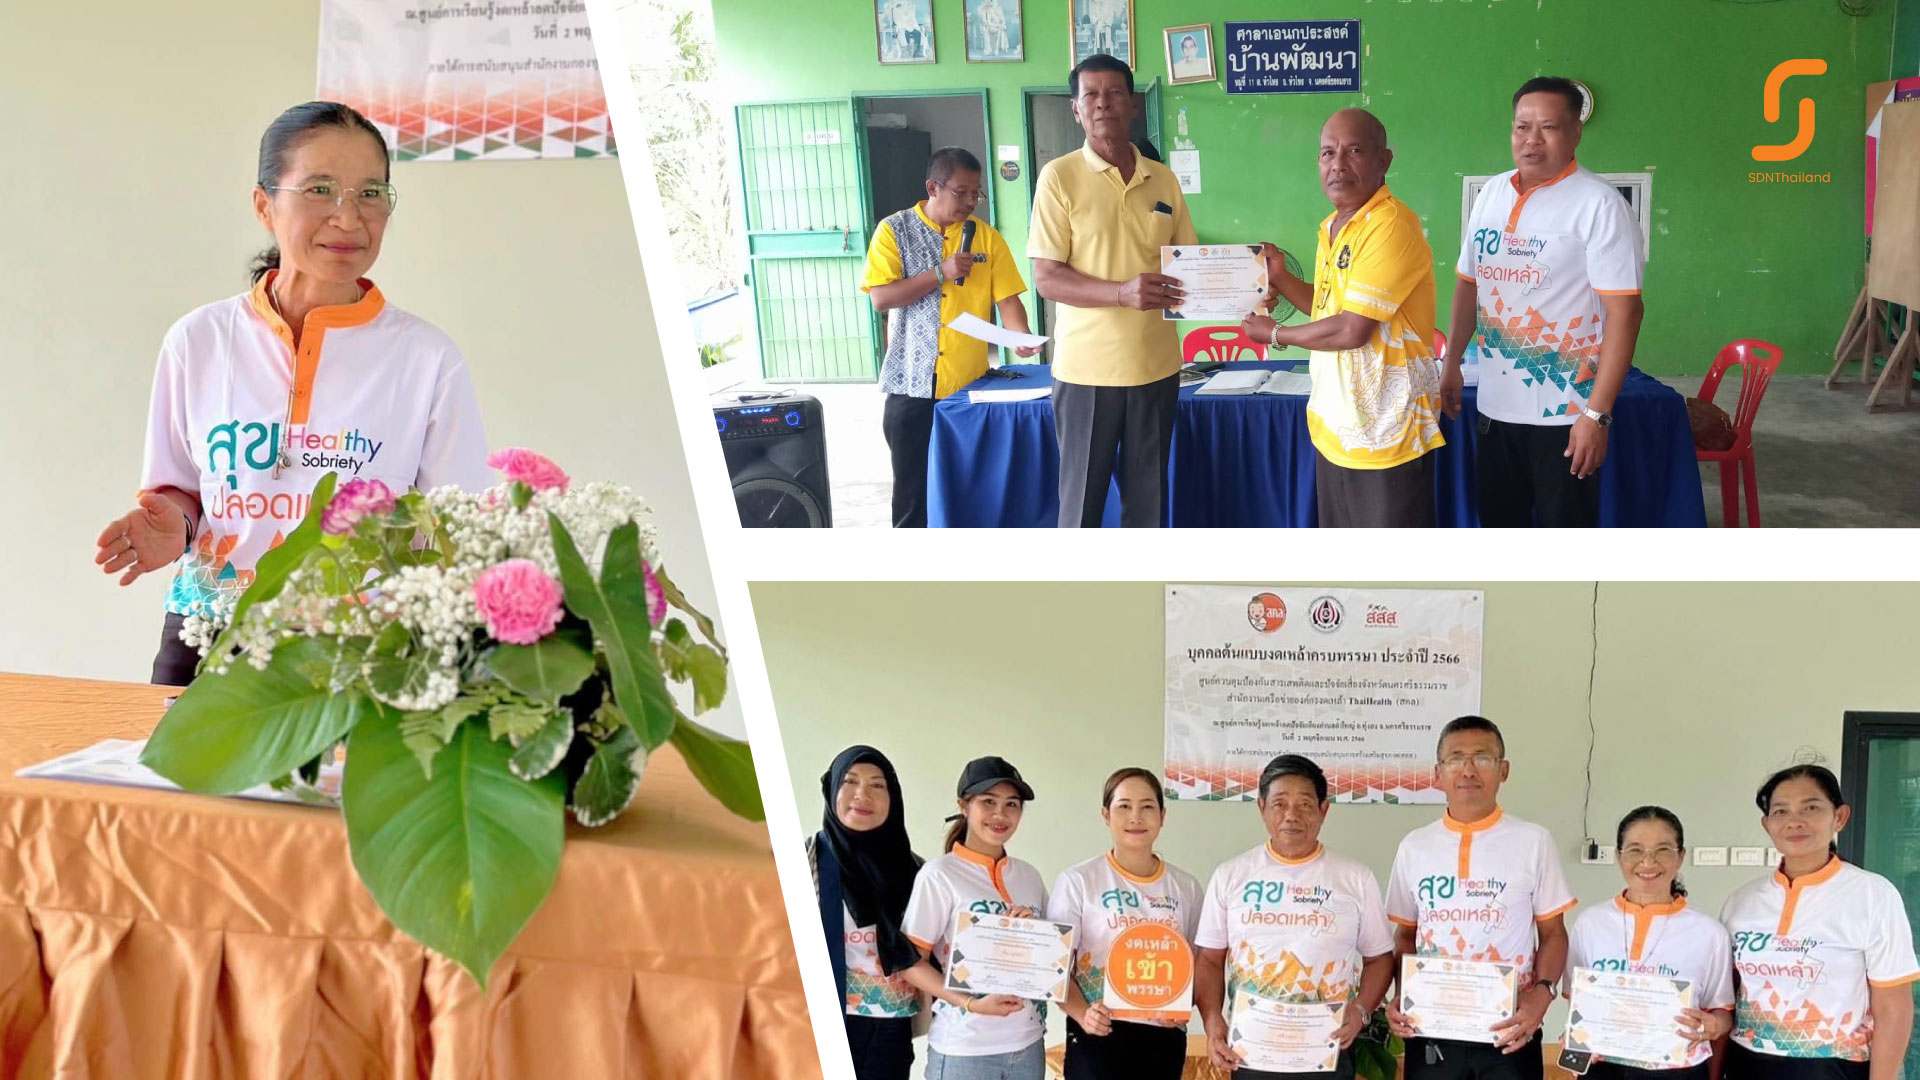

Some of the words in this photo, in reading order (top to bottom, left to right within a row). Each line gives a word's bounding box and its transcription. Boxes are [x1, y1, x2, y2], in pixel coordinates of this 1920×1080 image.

[533, 20, 558, 39] วันที่
[1236, 22, 1349, 41] ศาลาเอนกประสงค์
[1228, 42, 1357, 72] บ้านพัฒนา
[1474, 227, 1502, 263] สุข
[1502, 233, 1548, 252] Healthy
[1507, 247, 1537, 258] Sobriety
[1477, 264, 1541, 285] ลอดเหล้า
[206, 419, 280, 490] สุข
[288, 426, 383, 463] Healthy
[301, 452, 363, 475] Sobriety
[1187, 642, 1377, 665] บุคคลต้นแบบงดเหล้าครบพรรษา
[1380, 647, 1429, 664] ประจำปี
[1432, 653, 1461, 665] 2566
[1348, 697, 1393, 706] ThaiHealth
[1101, 888, 1139, 914] สุข
[1243, 880, 1284, 911] สุข
[1286, 884, 1332, 899] Healthy
[1293, 895, 1324, 905] Sobriety
[1418, 875, 1455, 909] สุข
[1458, 877, 1507, 892] Healthy
[1466, 890, 1498, 899] Sobriety
[1241, 909, 1329, 928] ปลอดเหล้า
[1422, 904, 1501, 923] ปลอดเหล้า
[1125, 935, 1177, 950] งดเหล้า
[1734, 930, 1772, 960] สุข
[1126, 951, 1173, 981] เข้า
[1736, 960, 1814, 979] ลอดเหล้า
[1126, 983, 1172, 995] พรรษา
